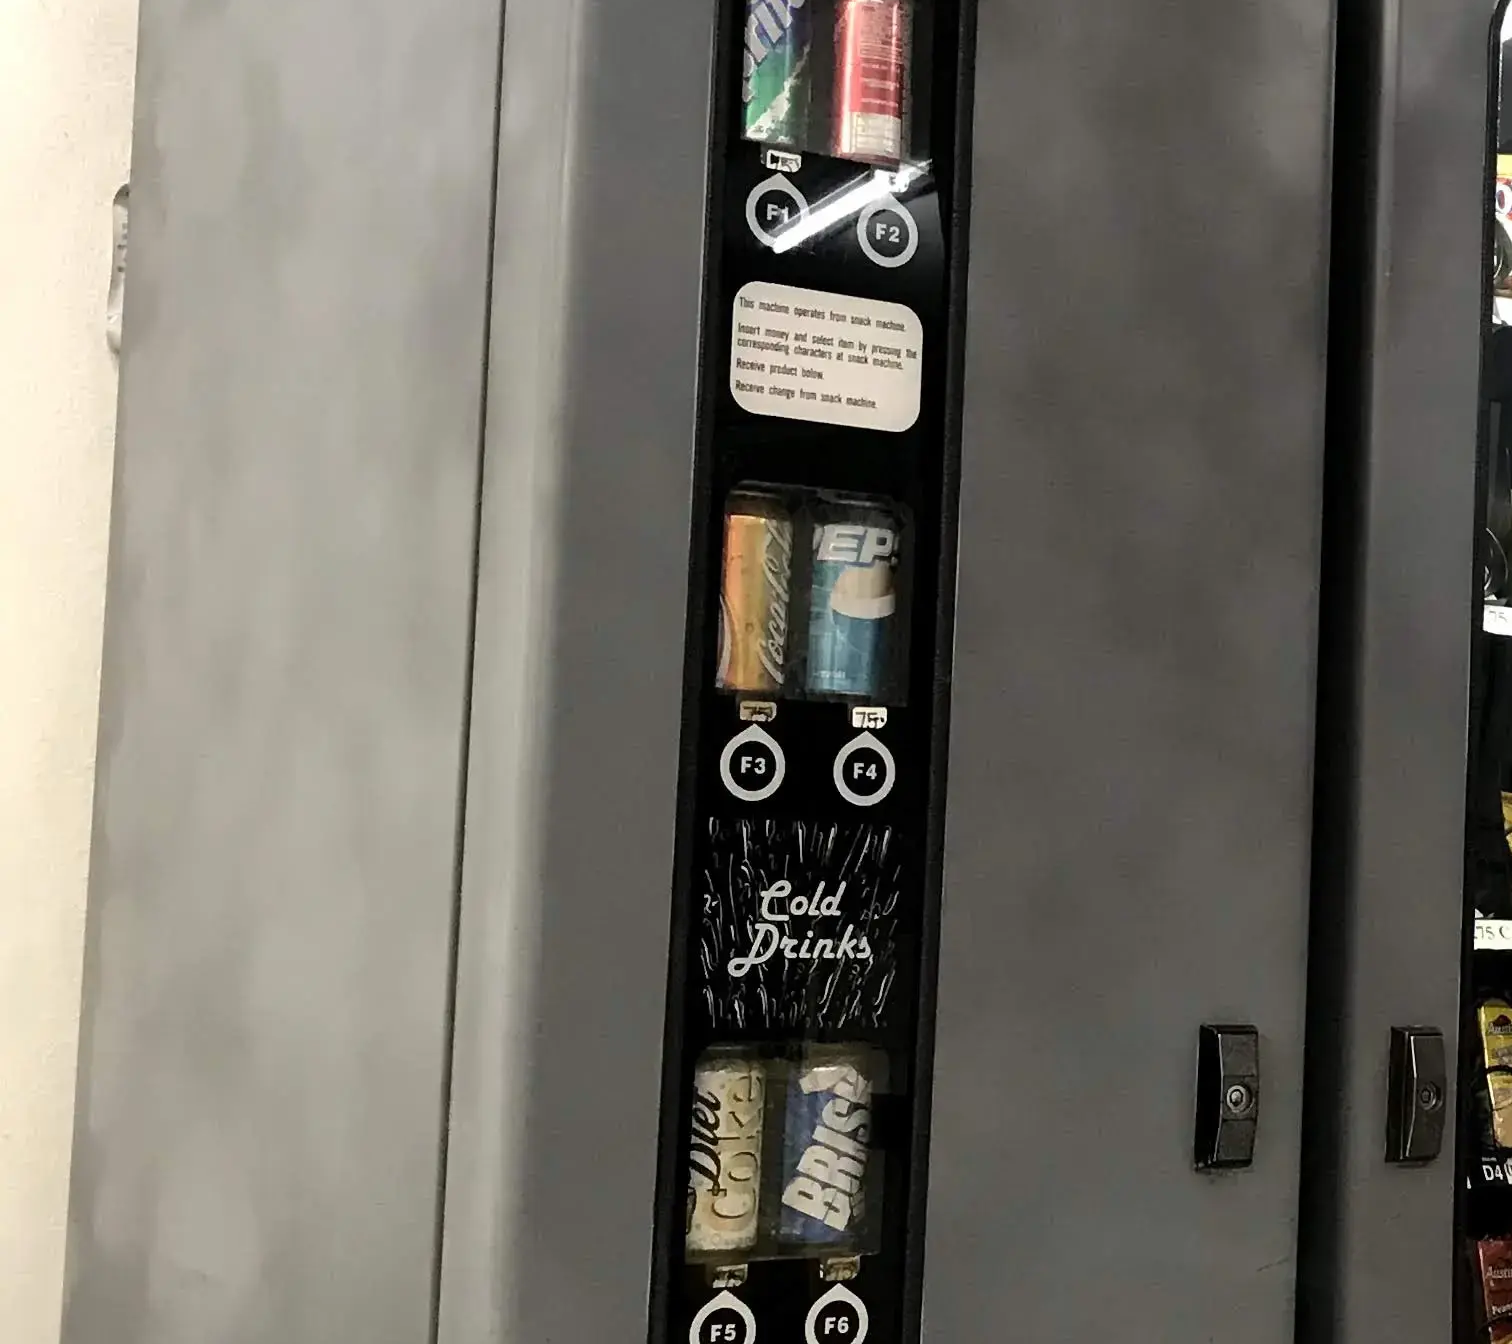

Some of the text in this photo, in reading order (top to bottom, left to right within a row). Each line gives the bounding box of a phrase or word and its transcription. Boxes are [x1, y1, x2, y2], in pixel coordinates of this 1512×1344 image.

[766, 204, 789, 222] F1
[876, 223, 899, 242] F2
[794, 306, 825, 320] operates
[830, 310, 846, 323] from
[851, 314, 871, 326] snack
[737, 337, 789, 356] corresponding
[794, 346, 832, 360] characters
[859, 341, 867, 353] by
[736, 358, 765, 372] Receive
[770, 363, 797, 377] product
[736, 379, 764, 394] Receive
[769, 385, 795, 400] change
[800, 388, 816, 400] from
[821, 391, 842, 404] snack
[741, 757, 766, 774] F3
[853, 763, 877, 780] F4
[761, 880, 847, 921] Cold
[727, 923, 873, 977] Drinks
[1482, 1165, 1503, 1180] D4
[711, 1324, 737, 1342] F5
[824, 1317, 850, 1335] F6
